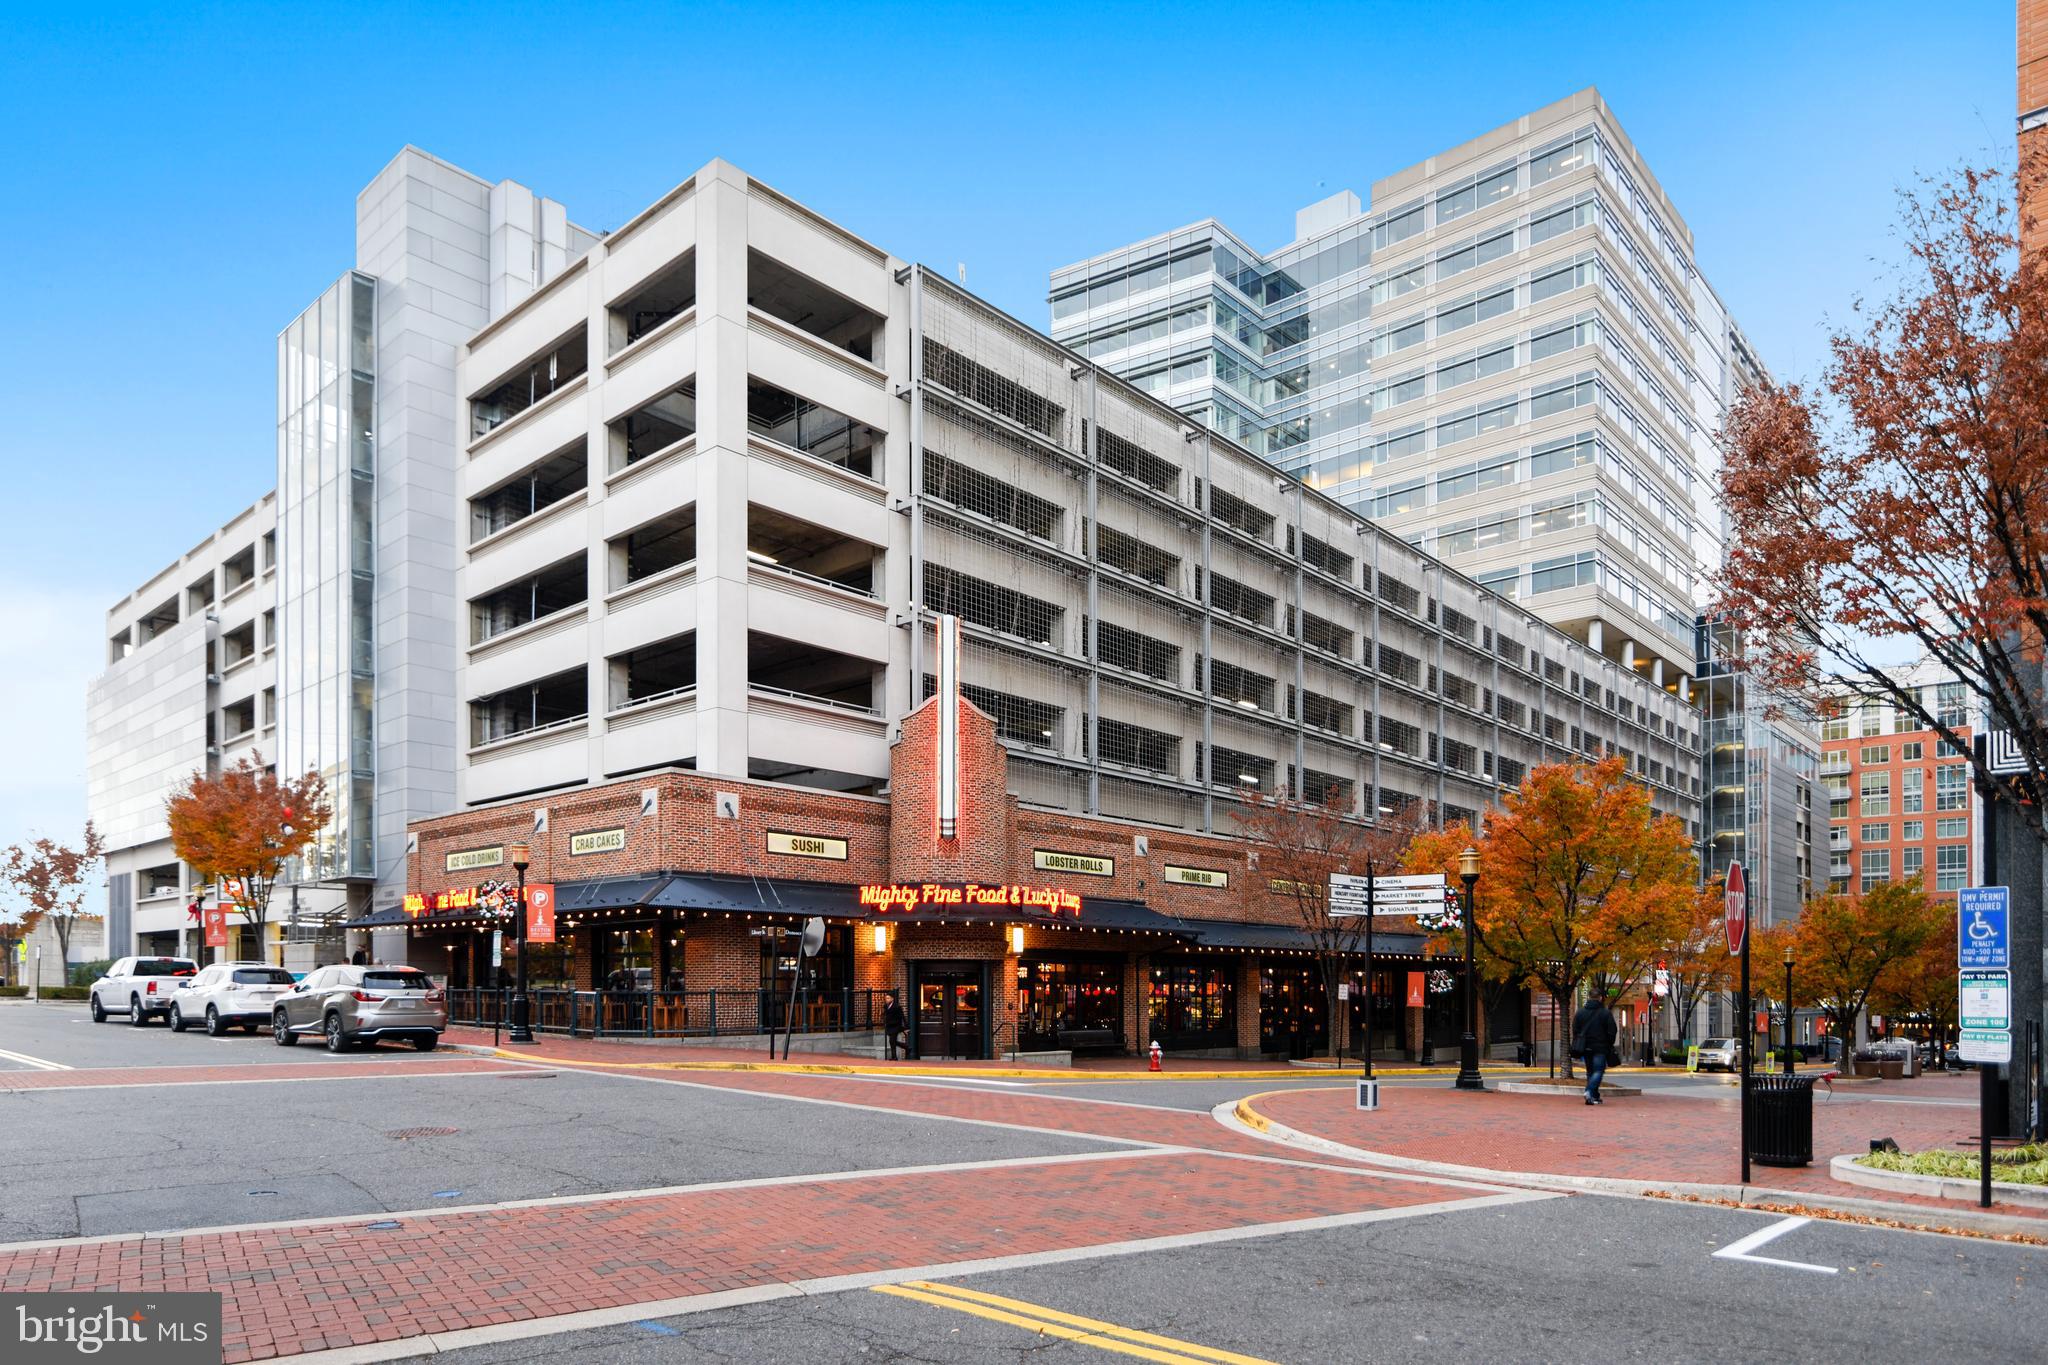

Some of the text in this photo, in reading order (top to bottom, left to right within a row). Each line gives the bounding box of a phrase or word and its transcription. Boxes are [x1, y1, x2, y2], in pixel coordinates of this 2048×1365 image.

[575, 834, 621, 851] CRAB CAKES
[791, 838, 825, 854] SUSHI
[450, 850, 500, 868] ICE COLD DRINKS
[1045, 854, 1103, 872] LOBSTER ROLLS
[1181, 870, 1212, 884] PRIME RIB
[859, 885, 918, 911] Mighty
[922, 884, 962, 903] Fine
[965, 884, 1008, 904] Food
[1009, 885, 1021, 905] &
[1021, 886, 1060, 913] Lucky
[1962, 892, 2005, 902] DMV PERMIT
[1727, 890, 1744, 921] STOP
[1965, 901, 2001, 911] REQUIRED
[1971, 940, 1995, 948] PENALTY
